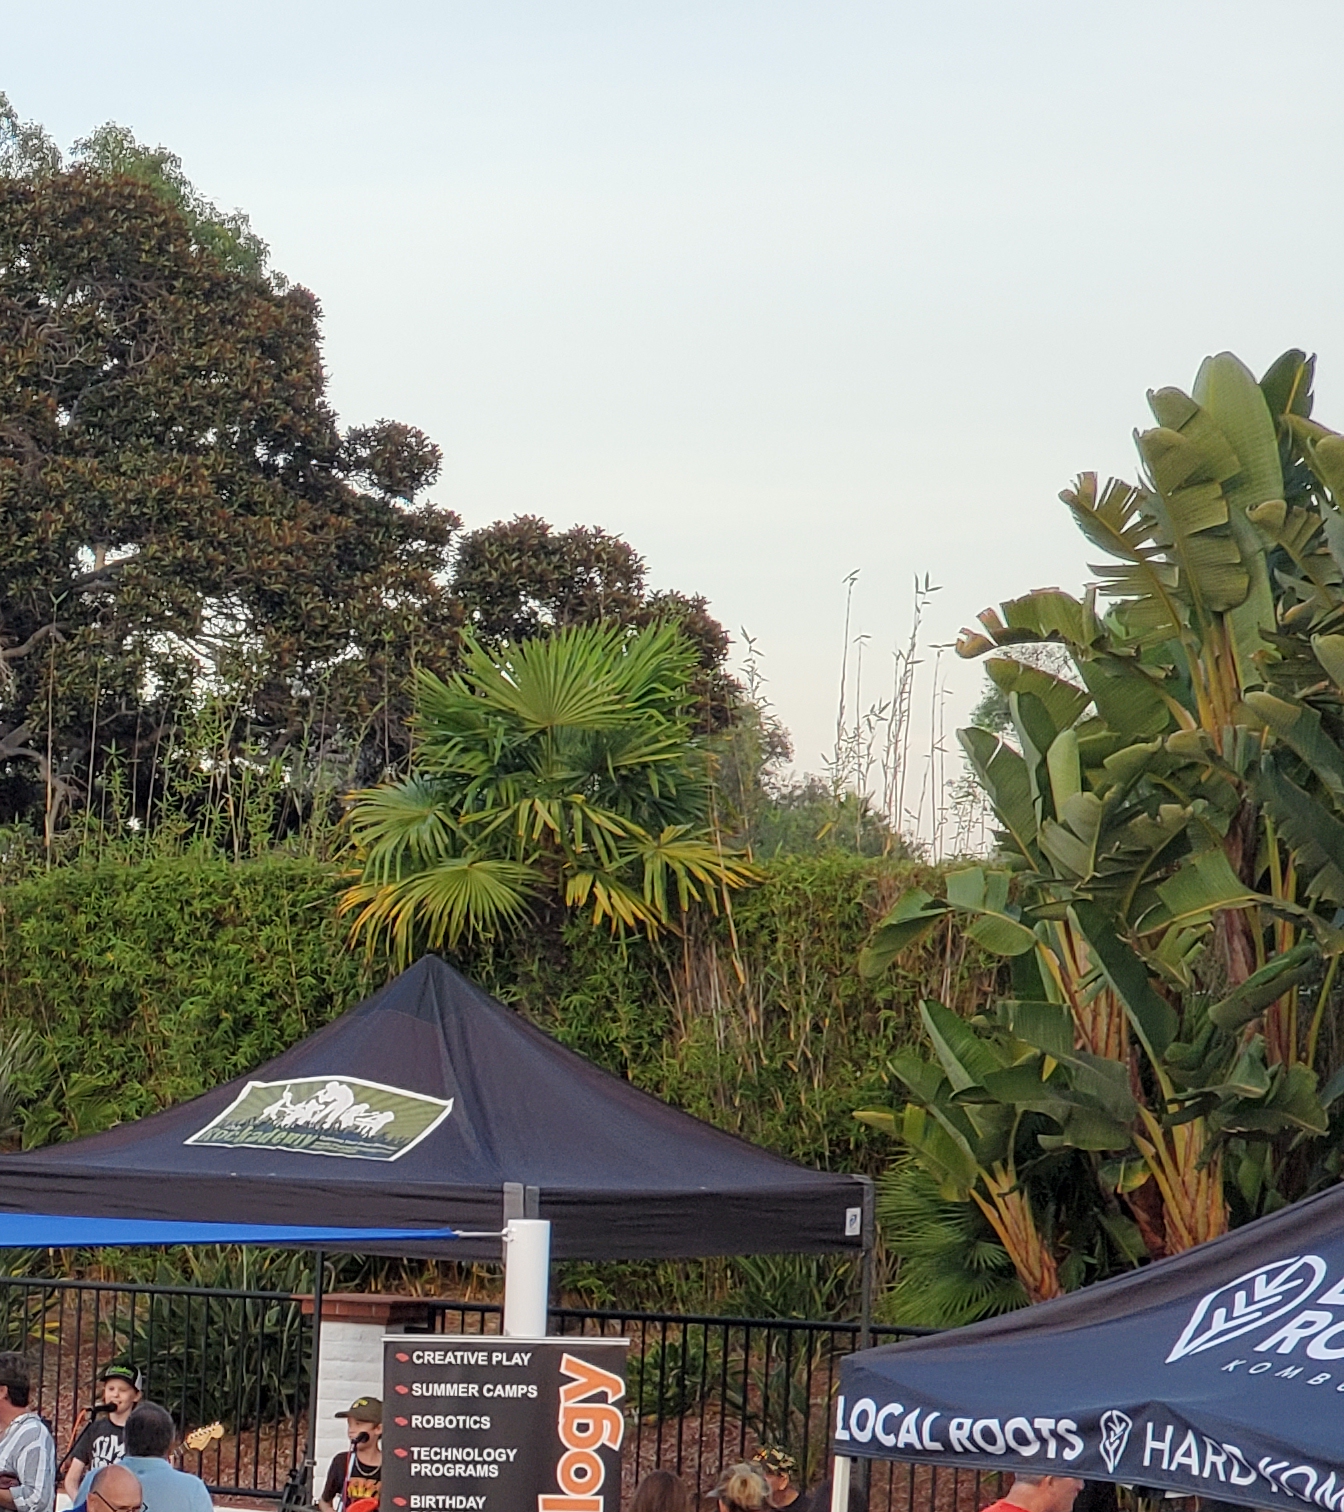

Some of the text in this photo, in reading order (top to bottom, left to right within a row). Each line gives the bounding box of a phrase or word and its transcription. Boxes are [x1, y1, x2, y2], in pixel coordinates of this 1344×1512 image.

[412, 1351, 532, 1366] CREATIVE PLAY
[412, 1383, 538, 1398] SUMMER CAMPS
[411, 1415, 491, 1429] ROBOTICS
[835, 1395, 1084, 1461] LOCAL ROOTS
[410, 1447, 517, 1462] TECHNOLOGY
[1143, 1421, 1257, 1487] HARD
[410, 1463, 499, 1477] PROGRAMS
[410, 1495, 487, 1509] BIRTHDAY
